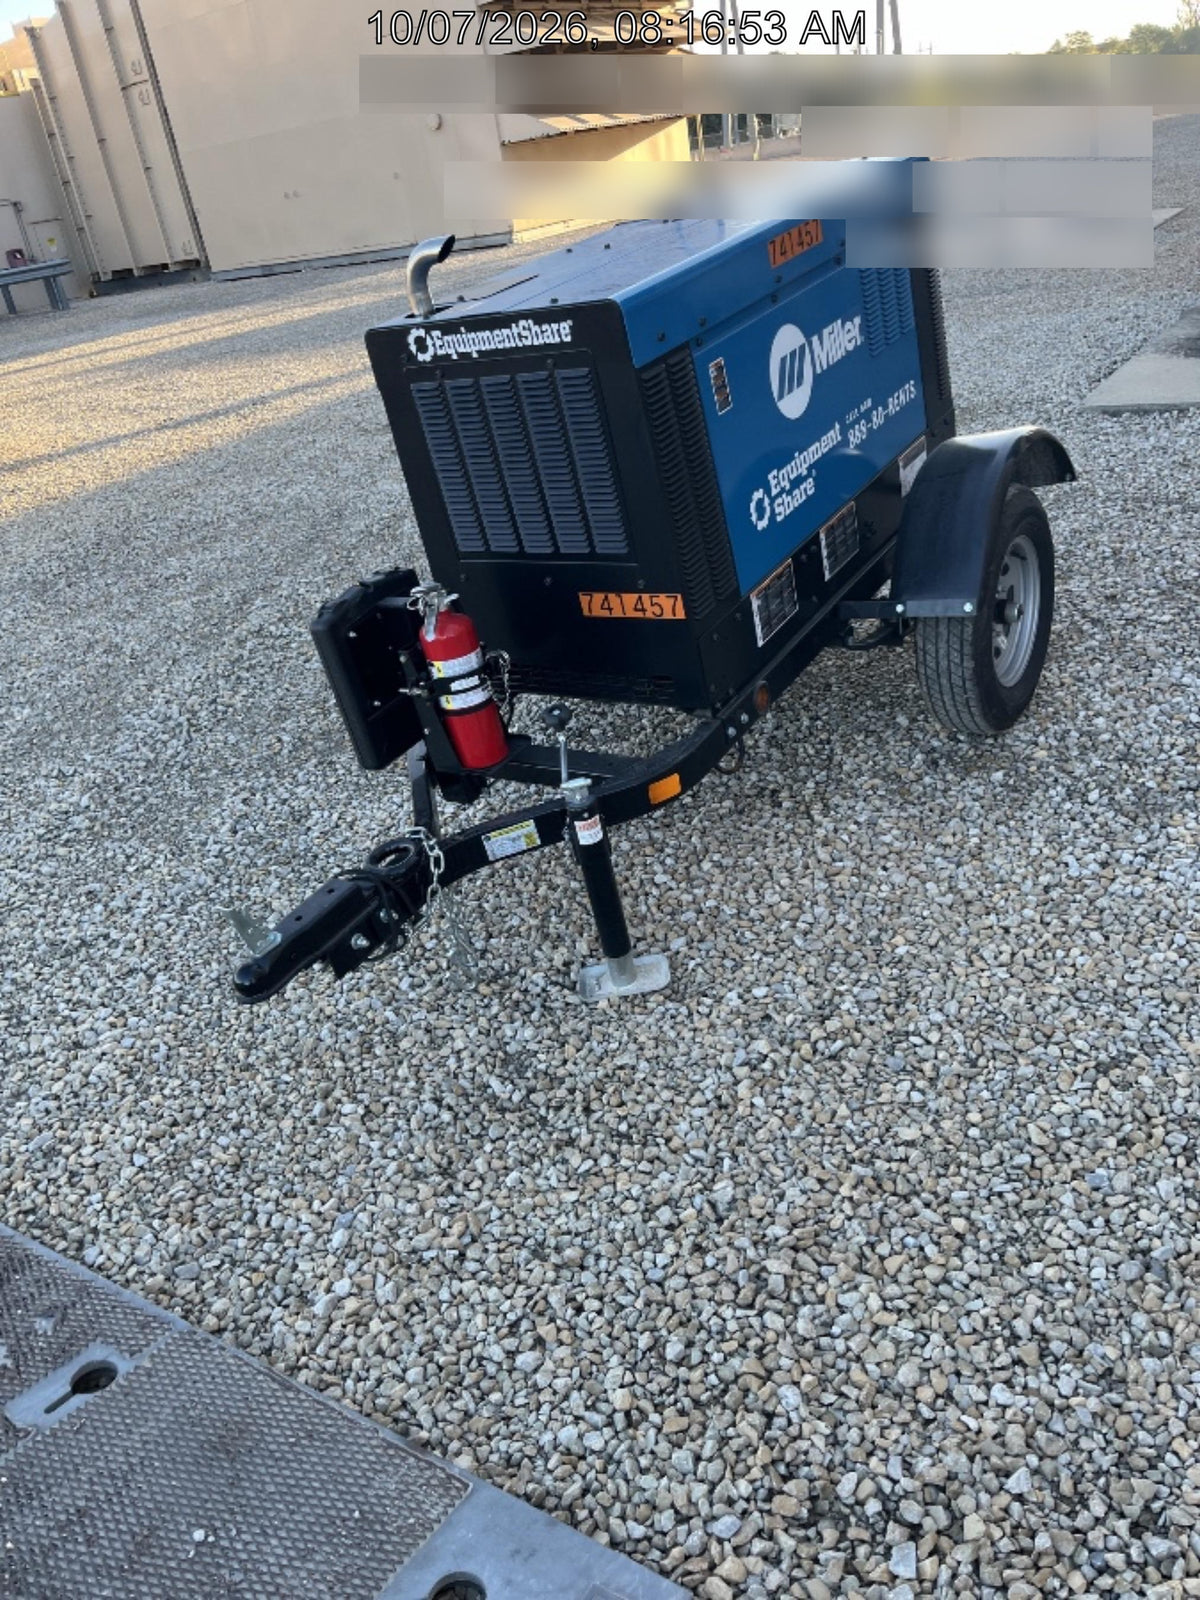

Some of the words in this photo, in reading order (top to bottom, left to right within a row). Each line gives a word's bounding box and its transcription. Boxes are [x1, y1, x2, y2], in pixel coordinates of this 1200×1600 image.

[768, 219, 820, 266] 741457
[432, 319, 571, 360] EquipmentShare
[811, 314, 862, 375] Miller
[768, 421, 842, 497] Equipment
[773, 477, 816, 522] Share
[581, 592, 679, 618] 741457
